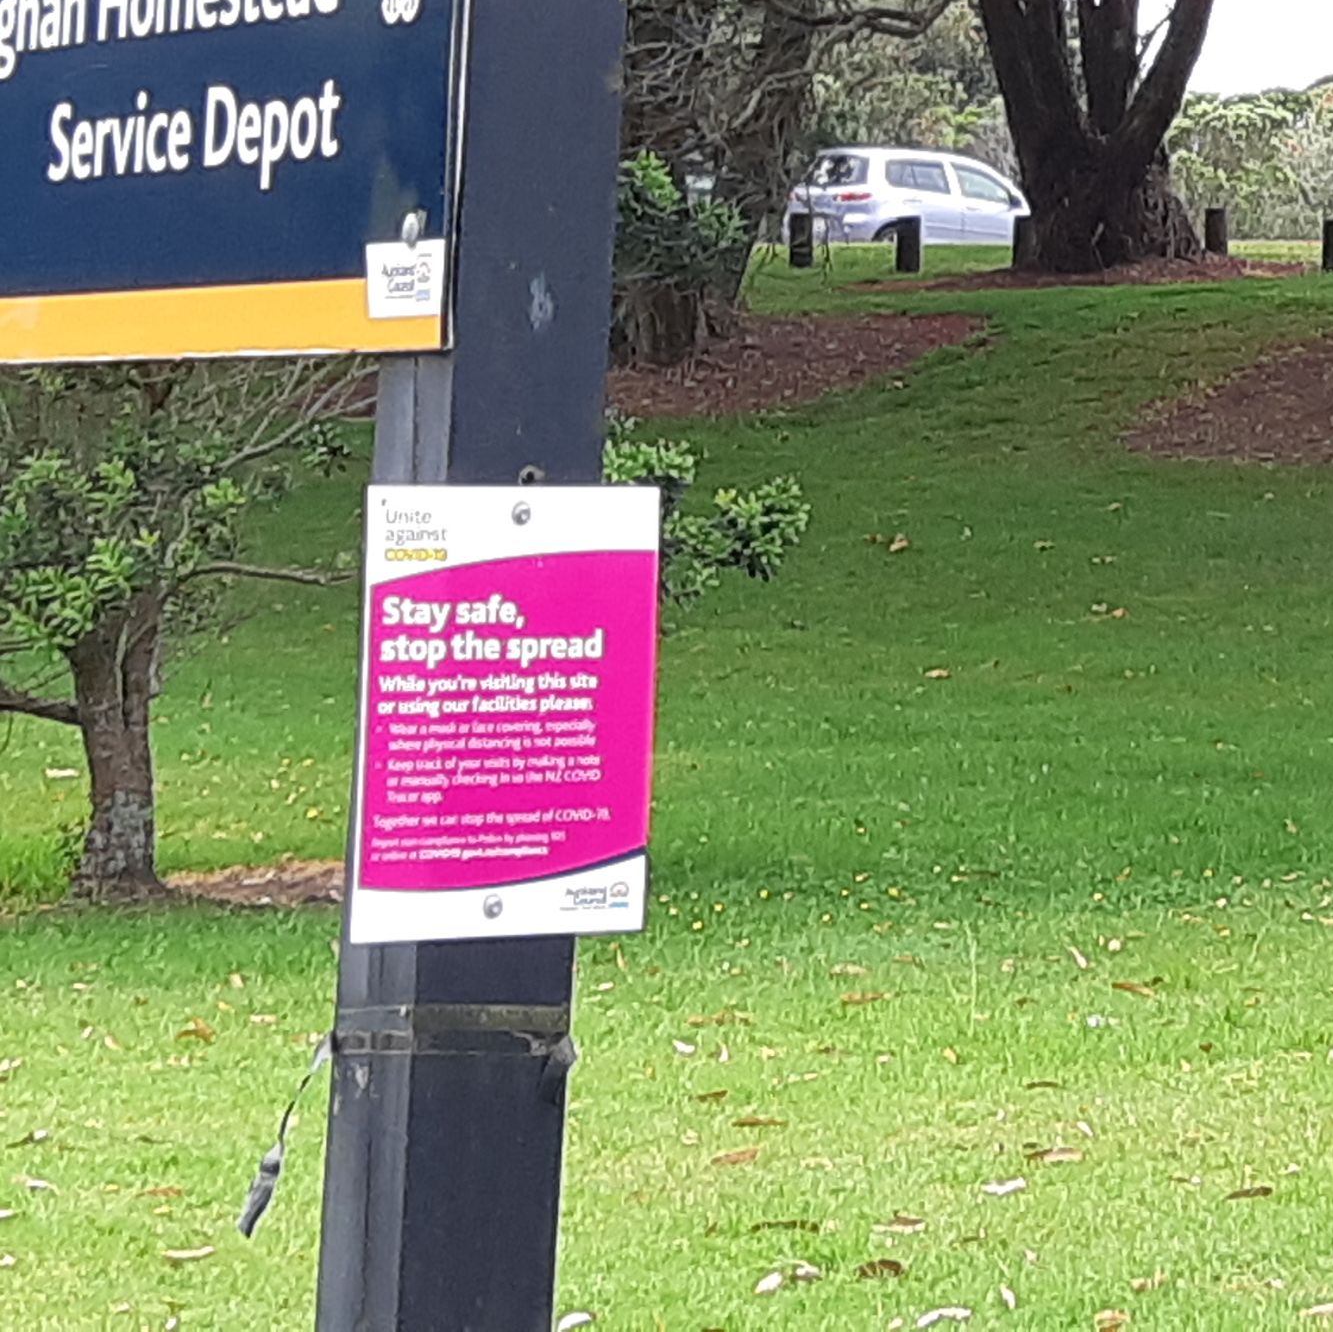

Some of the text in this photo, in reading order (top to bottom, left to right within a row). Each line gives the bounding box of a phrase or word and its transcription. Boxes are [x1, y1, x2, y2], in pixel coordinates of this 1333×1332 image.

[49, 80, 340, 189] Service Depot
[385, 509, 432, 524] Unite
[385, 528, 447, 546] against
[382, 593, 525, 634] Stay safe,
[379, 627, 604, 669] stop the spread
[378, 672, 599, 696] While you're visiting this site
[377, 701, 396, 714] or
[398, 697, 440, 718] using
[442, 699, 470, 713] our
[472, 695, 538, 713] facilities
